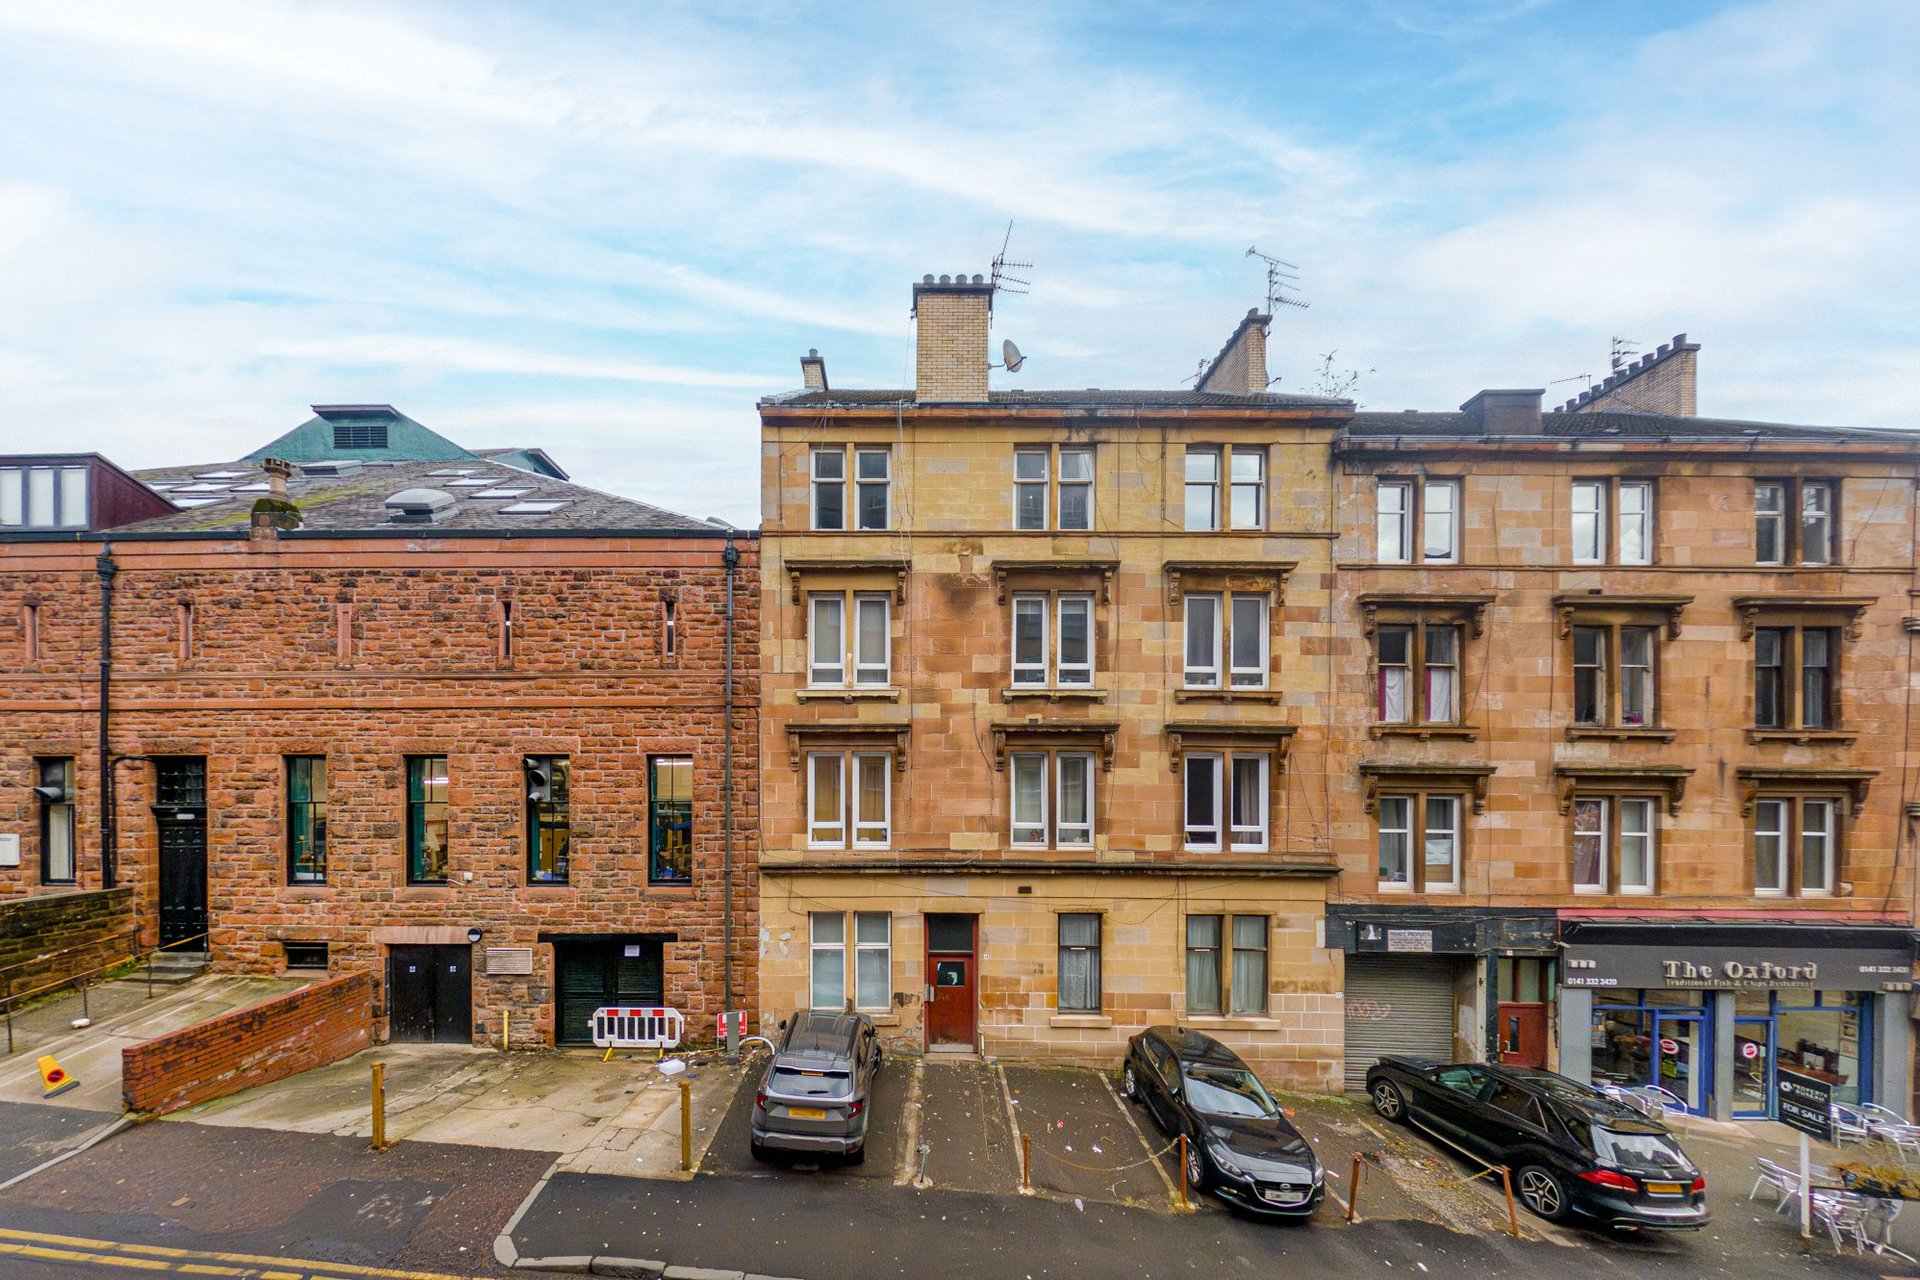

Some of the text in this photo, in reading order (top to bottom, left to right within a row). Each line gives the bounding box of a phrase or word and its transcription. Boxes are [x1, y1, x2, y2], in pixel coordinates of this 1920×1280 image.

[1662, 960, 1818, 979] The Oxford
[1567, 977, 1617, 986] 0141 332 3420
[1665, 979, 1712, 987] Traditional
[1714, 979, 1732, 987] Fish
[1792, 1083, 1828, 1098] PROPERTY
[1783, 1102, 1826, 1124] FOR SALE
